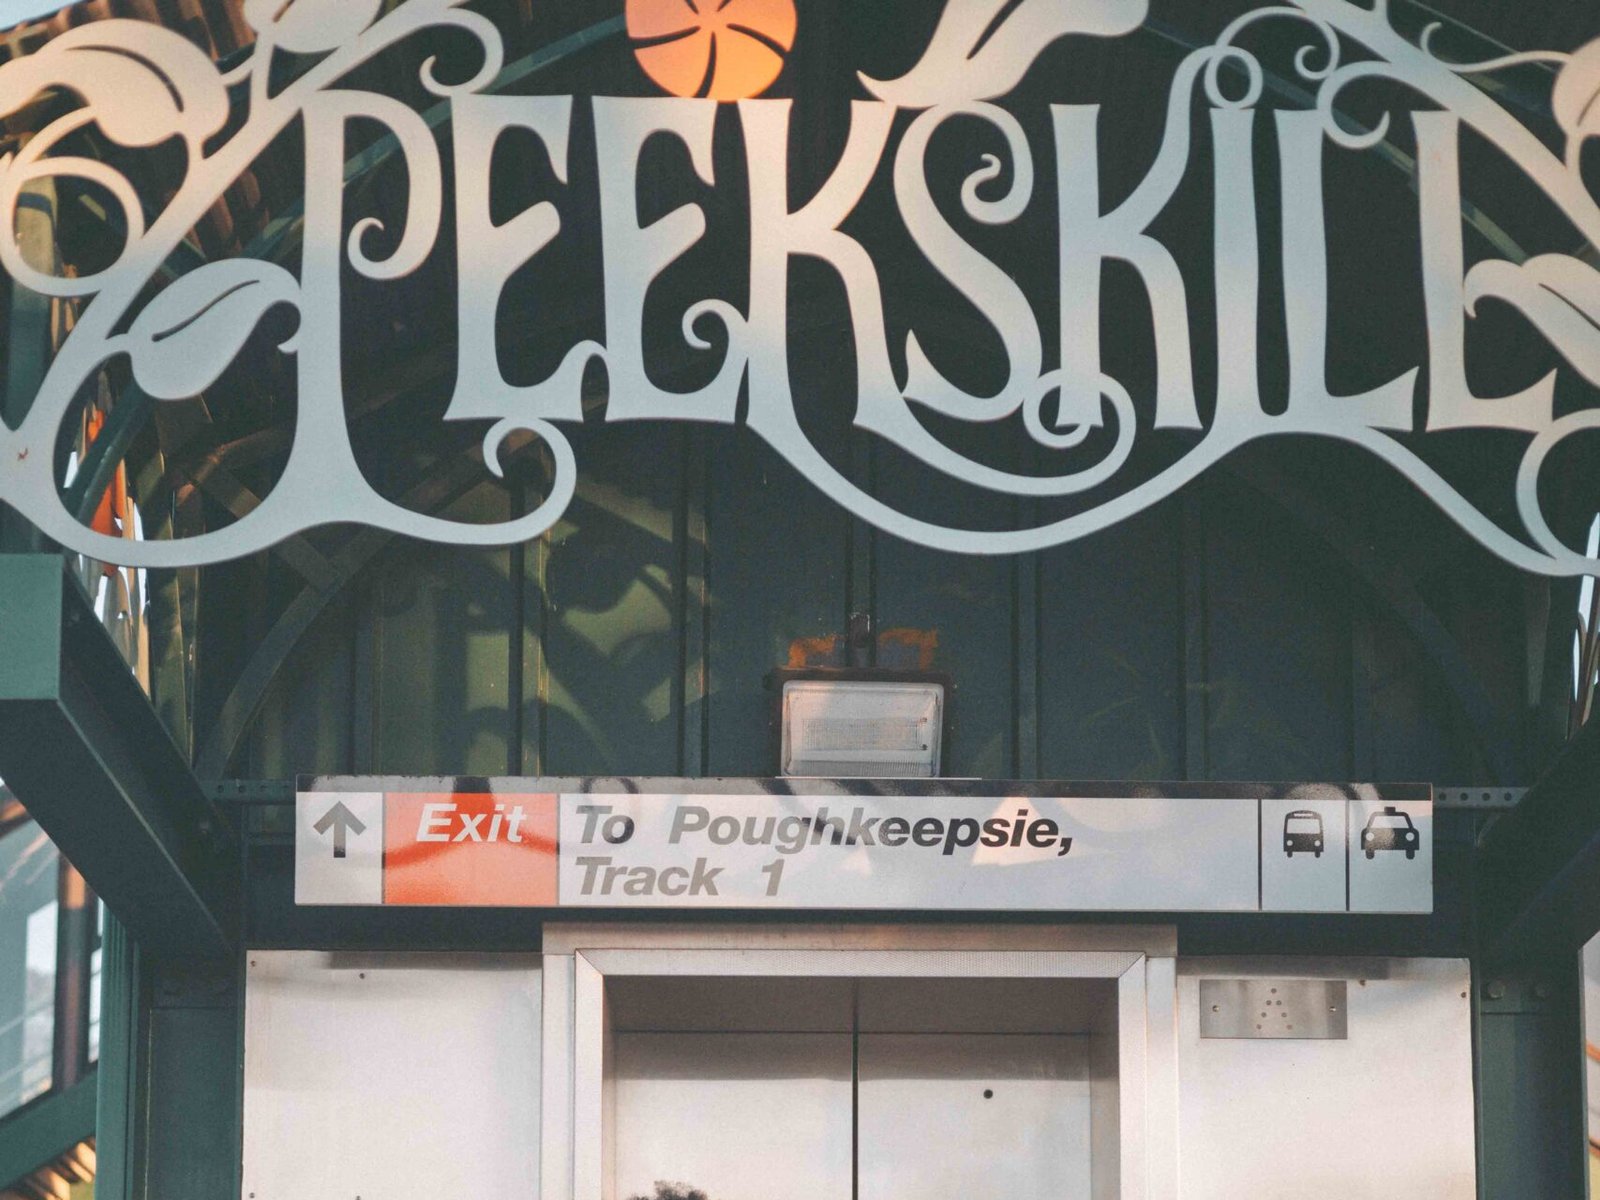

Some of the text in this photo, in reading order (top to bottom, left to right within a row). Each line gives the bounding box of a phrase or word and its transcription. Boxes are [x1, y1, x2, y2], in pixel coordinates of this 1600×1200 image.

[250, 50, 1570, 550] PEEKSKILL
[416, 802, 528, 843] Exit
[576, 805, 1073, 856] To Poughkeepsie,
[576, 857, 785, 897] Track 1
